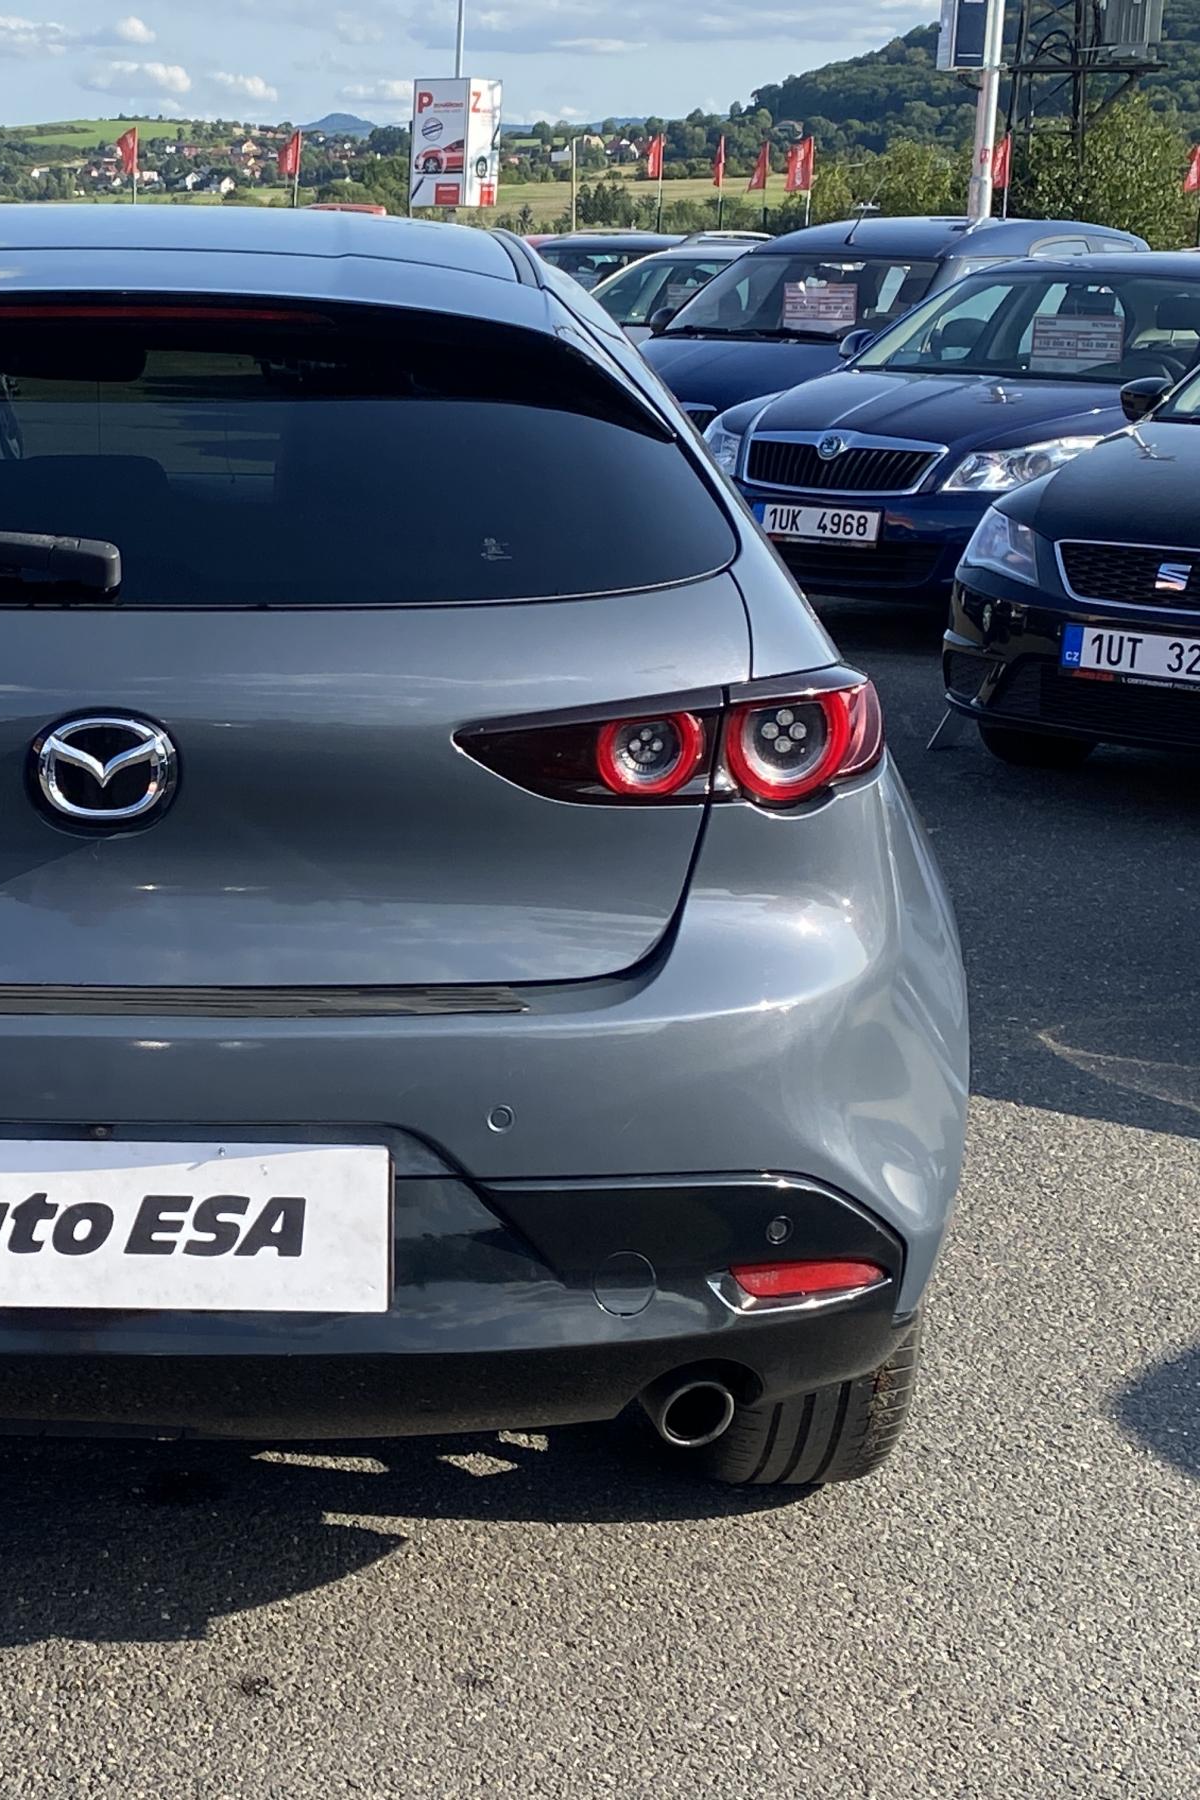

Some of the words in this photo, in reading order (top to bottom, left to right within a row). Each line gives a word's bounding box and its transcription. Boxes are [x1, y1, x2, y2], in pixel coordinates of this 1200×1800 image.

[769, 507, 802, 532] 1UK
[816, 511, 869, 537] 4968
[1065, 651, 1080, 661] CZ
[1091, 633, 1144, 669] 1UT
[122, 1193, 307, 1258] ESA
